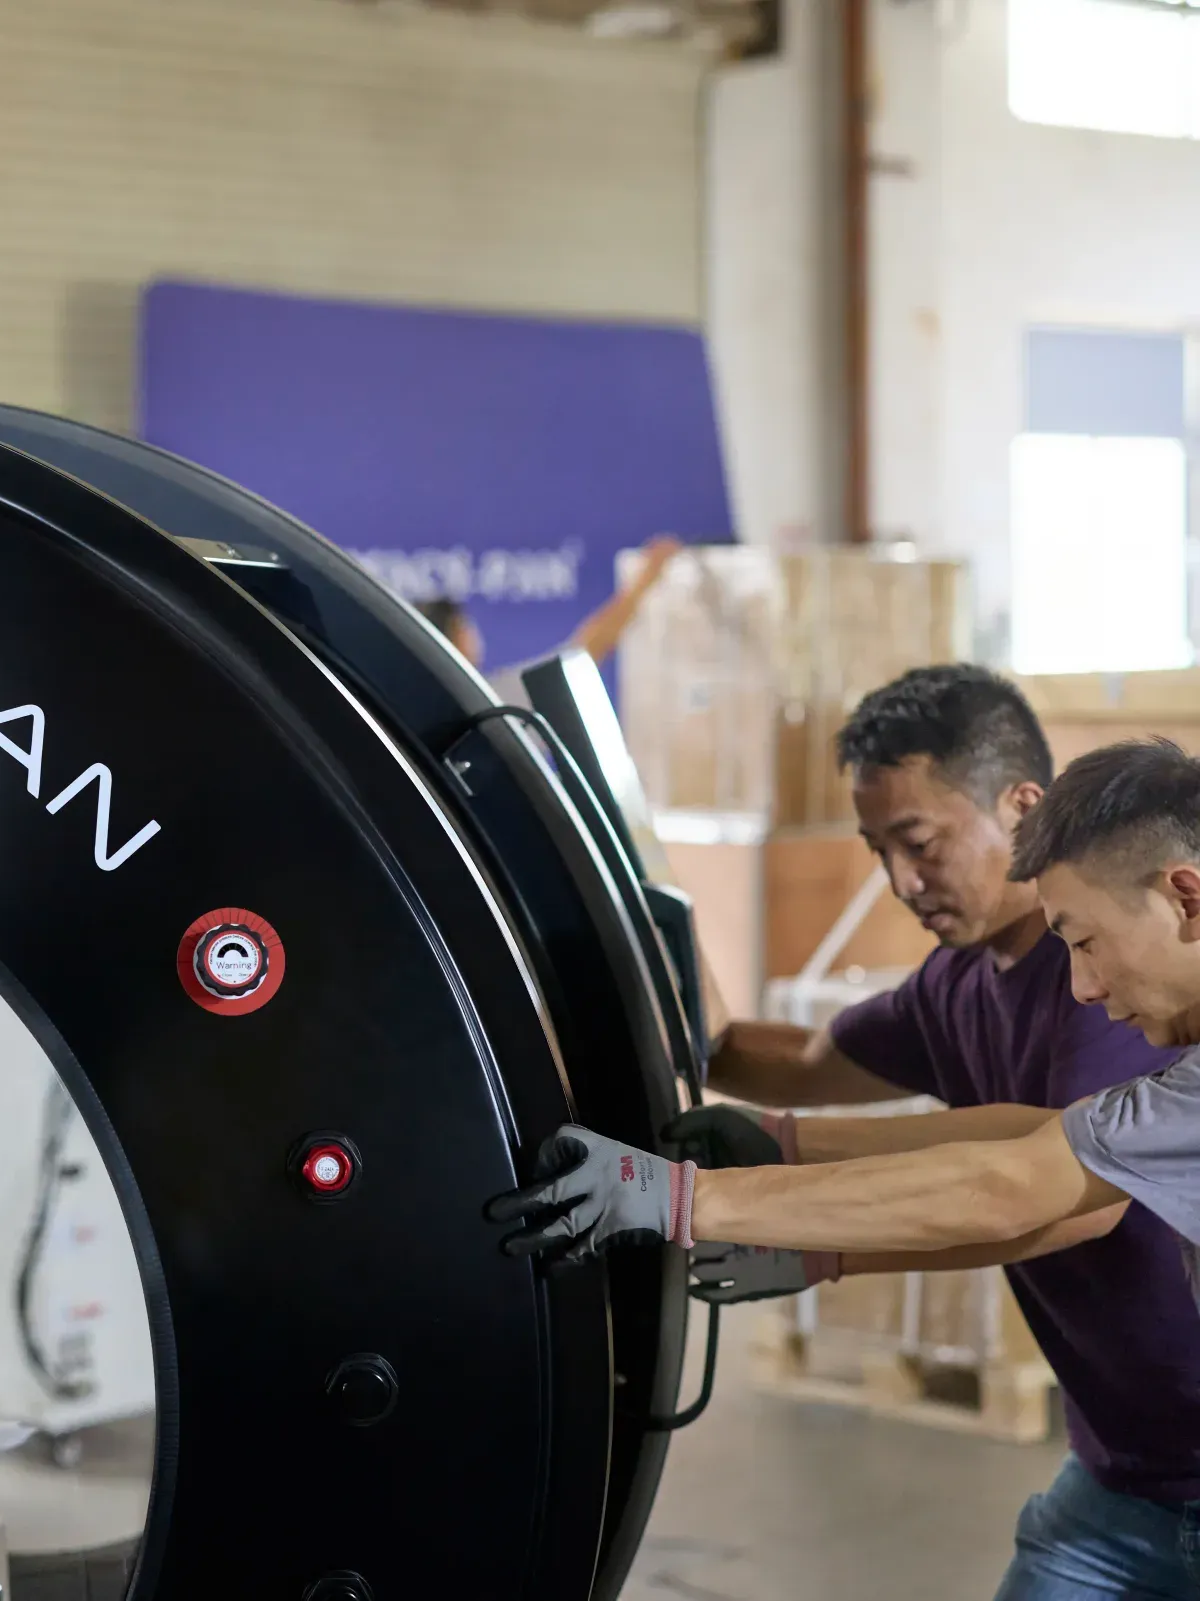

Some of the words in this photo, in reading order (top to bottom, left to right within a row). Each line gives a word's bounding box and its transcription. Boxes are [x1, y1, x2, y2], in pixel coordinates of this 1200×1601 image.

[216, 961, 252, 970] Warning
[620, 1155, 635, 1182] 3M
[639, 1161, 647, 1192] Comfort
